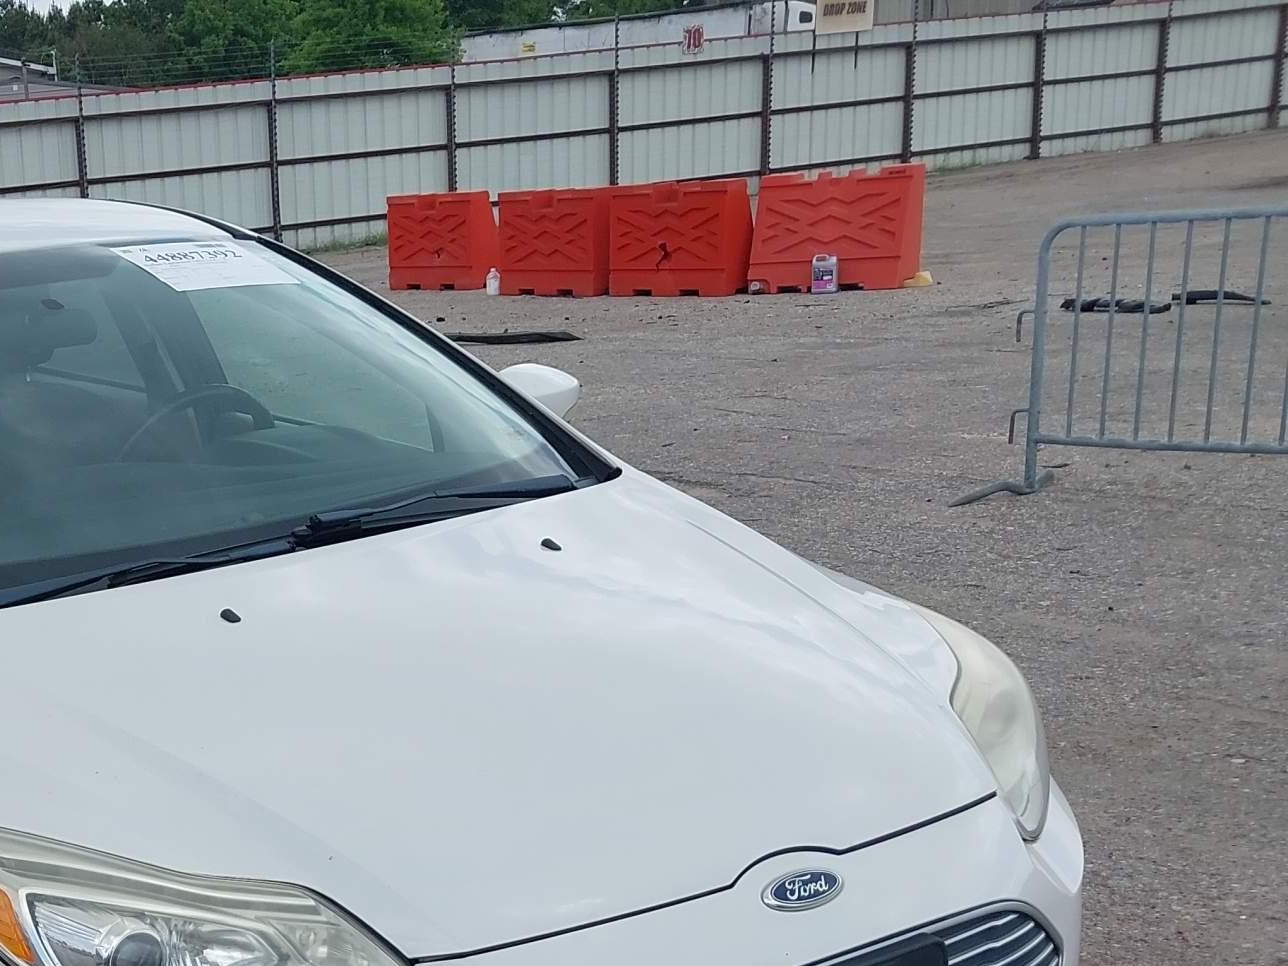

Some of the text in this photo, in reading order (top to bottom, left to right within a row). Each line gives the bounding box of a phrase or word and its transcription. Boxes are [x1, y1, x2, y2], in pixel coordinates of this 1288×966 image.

[823, 0, 868, 17] DROP ZONE
[143, 249, 243, 264] 44887392
[785, 874, 829, 900] Ford
